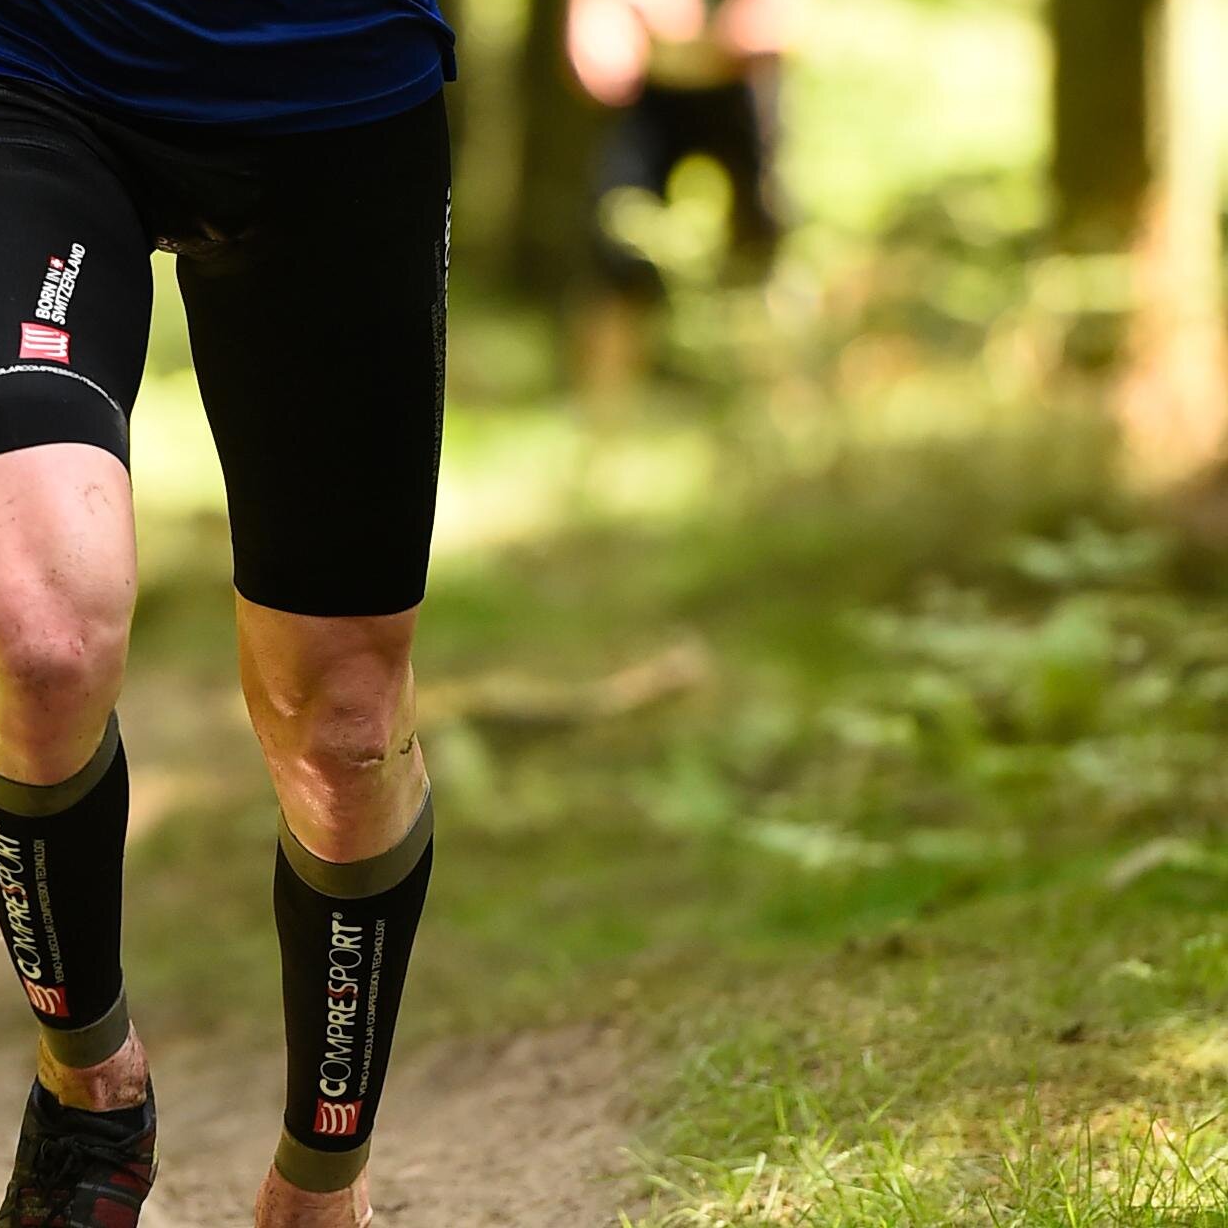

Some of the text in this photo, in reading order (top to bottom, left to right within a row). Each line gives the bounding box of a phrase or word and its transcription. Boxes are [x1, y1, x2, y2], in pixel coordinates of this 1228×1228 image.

[35, 267, 62, 320] BORN IN
[51, 242, 86, 325] SWITZERLAND
